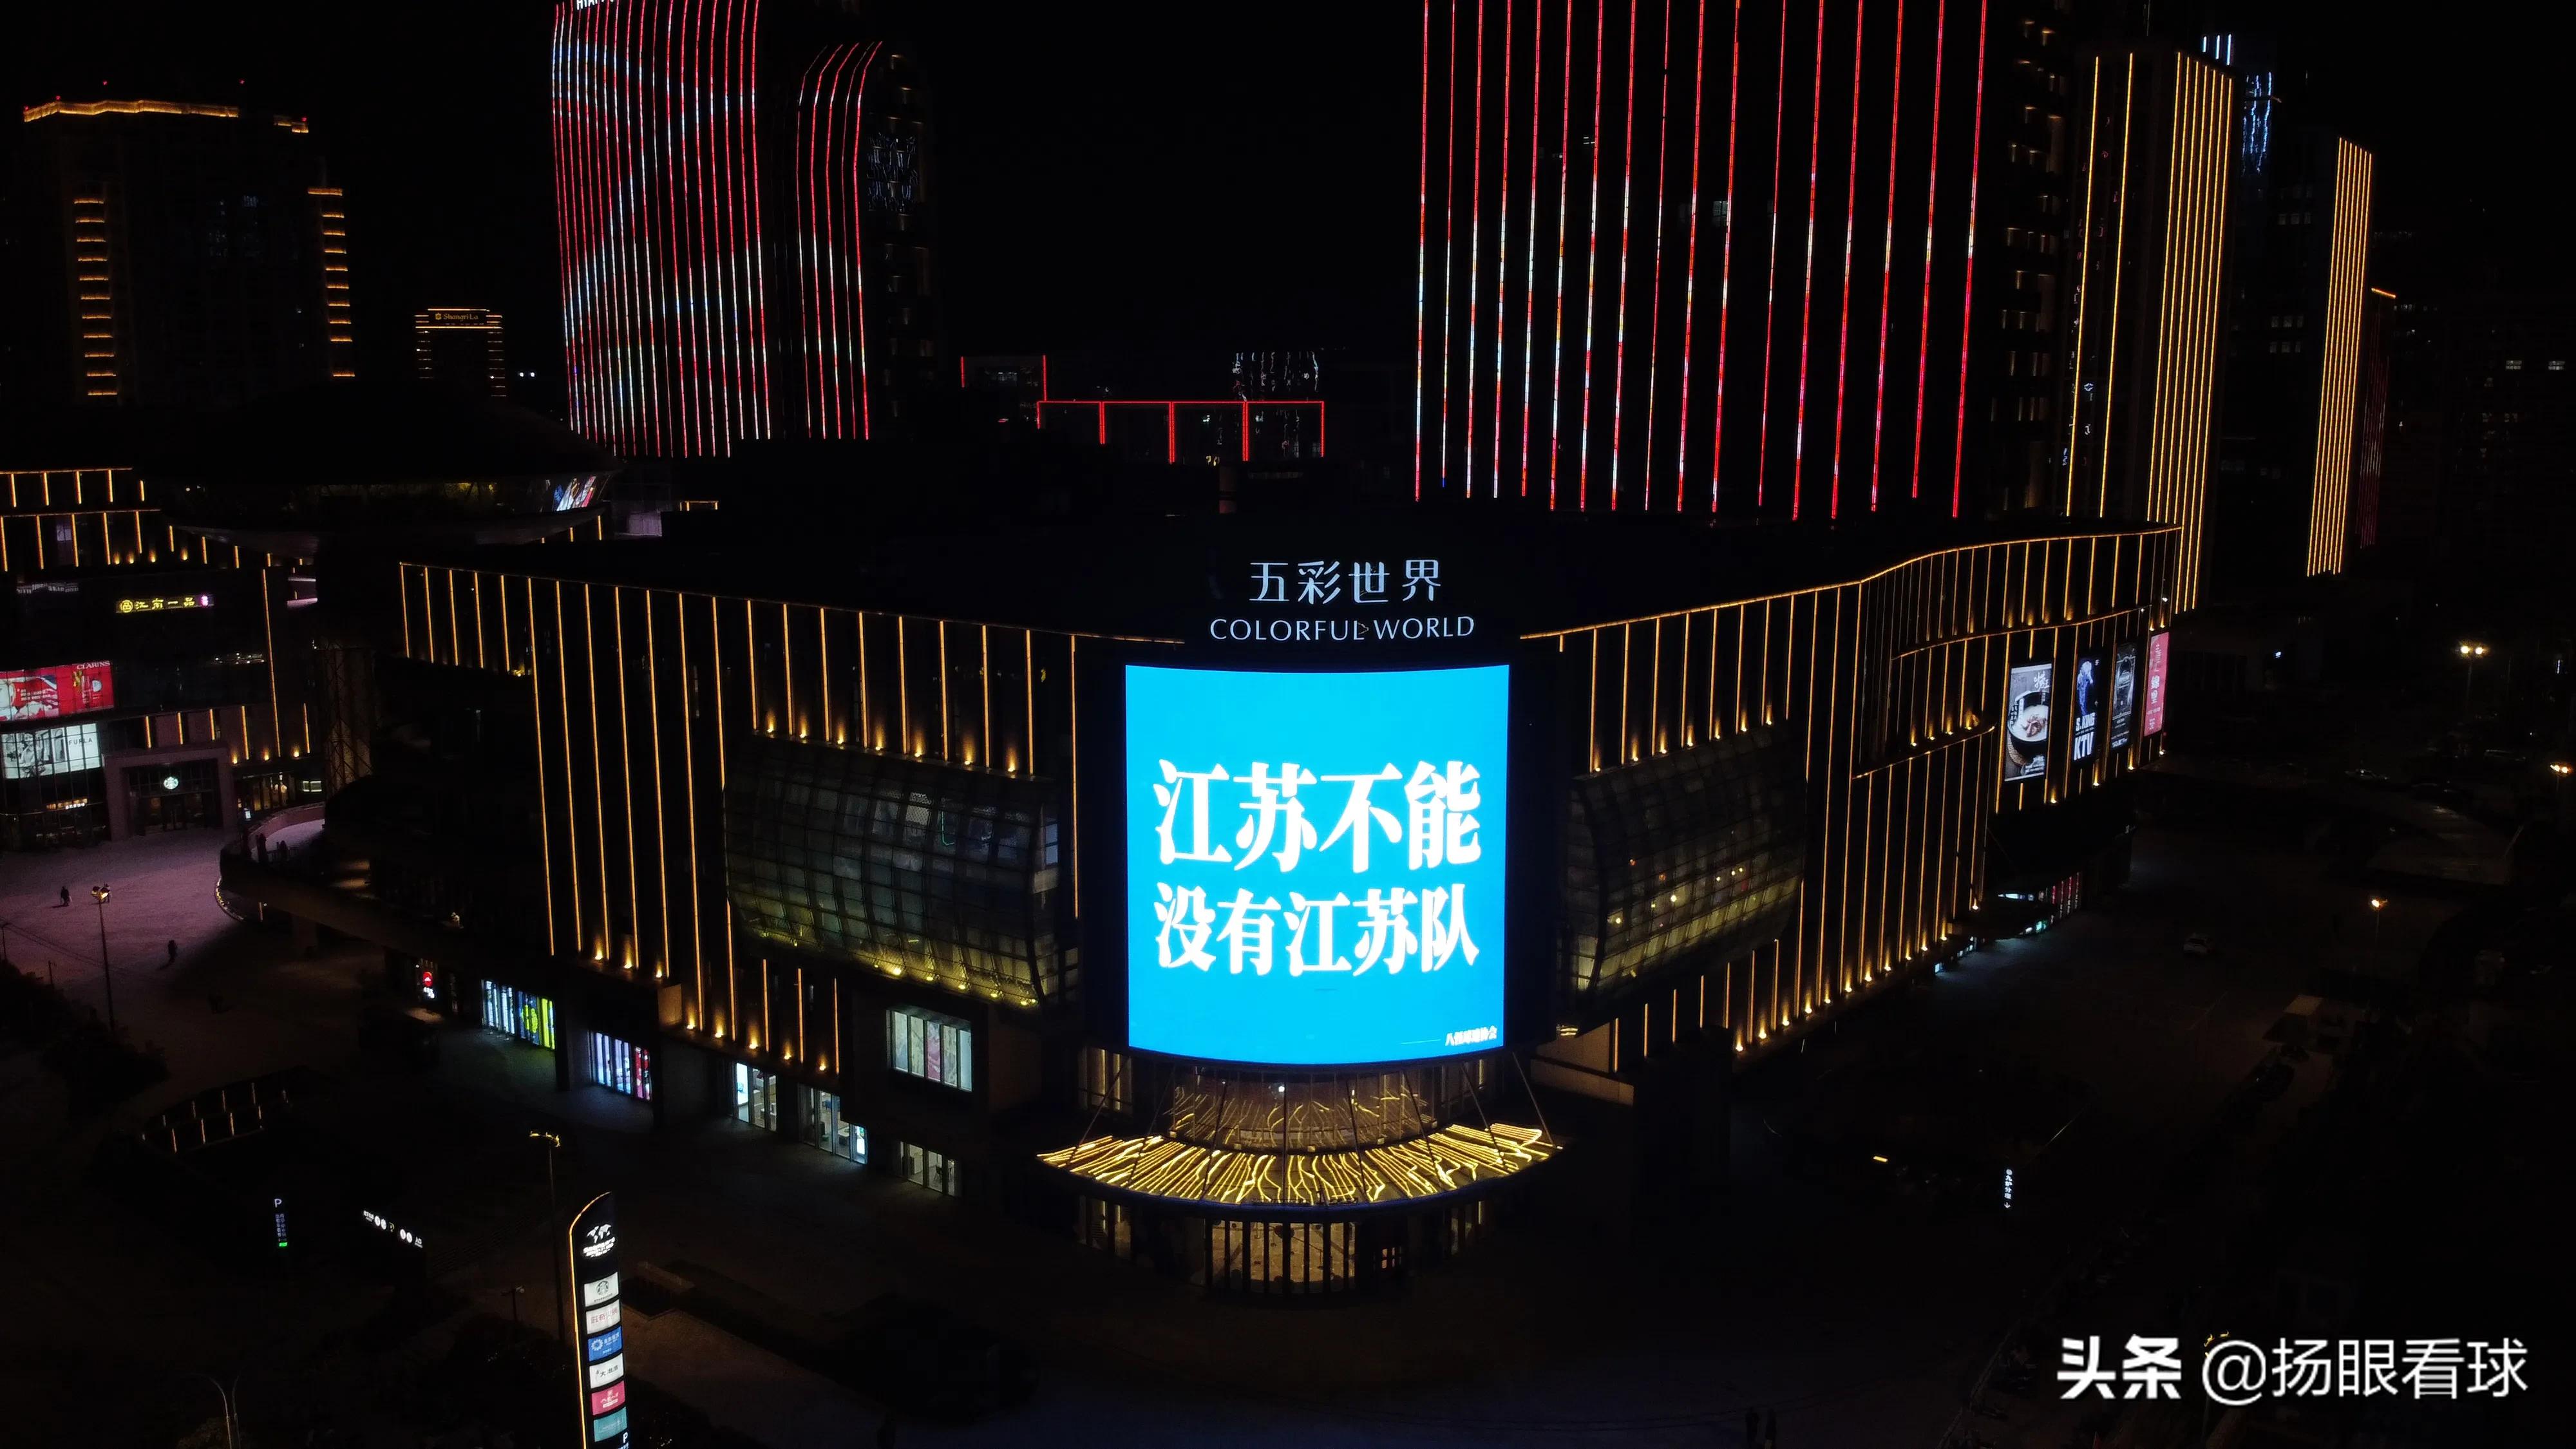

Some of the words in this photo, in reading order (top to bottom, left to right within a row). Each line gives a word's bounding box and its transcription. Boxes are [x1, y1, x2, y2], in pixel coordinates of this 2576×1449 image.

[1249, 559, 1441, 605] 五彩世界
[1211, 619, 1365, 640] COLORFUL
[1374, 616, 1473, 639] WORLD
[76, 660, 111, 670] CLARINS
[68, 737, 93, 746] FURLA
[2074, 732, 2095, 761] KTV
[1153, 759, 1481, 873] 江苏不能
[1154, 882, 1479, 976] 没有江苏队
[274, 1198, 282, 1208] P
[623, 1431, 629, 1444] P
